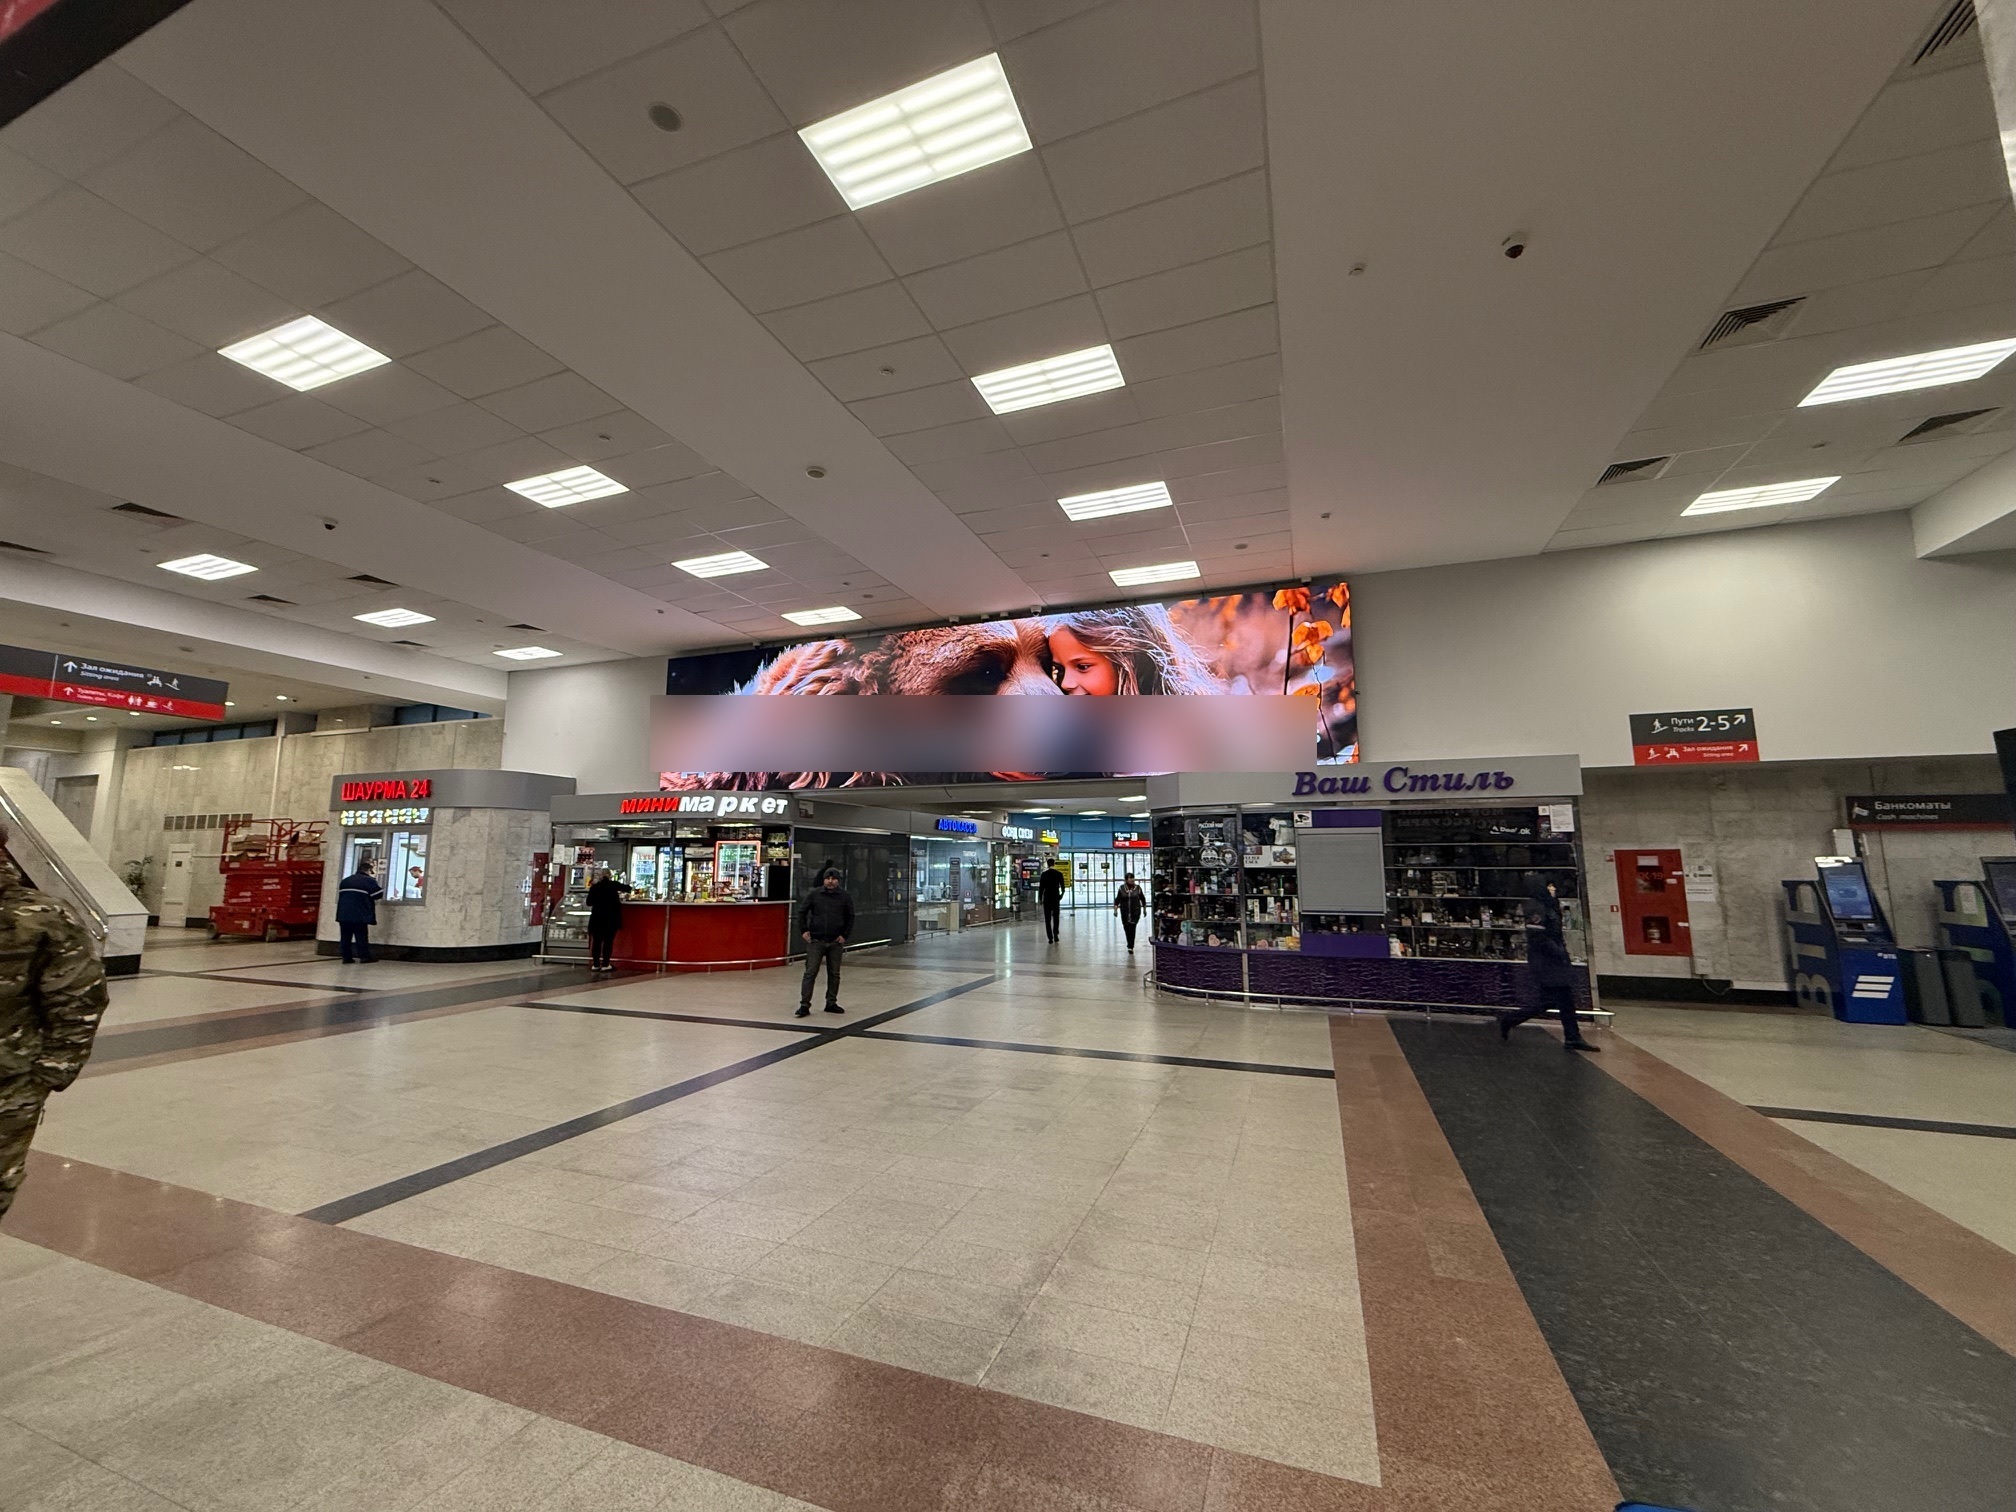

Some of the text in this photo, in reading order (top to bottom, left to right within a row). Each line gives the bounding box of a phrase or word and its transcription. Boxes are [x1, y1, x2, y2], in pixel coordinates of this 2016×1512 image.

[81, 662, 145, 679] Зал ожидания
[1670, 715, 1731, 732] Пути 2-5
[1696, 744, 1734, 752] ожидания
[341, 778, 430, 801] ШАУРМА 24
[1292, 766, 1514, 796] Ваш Стиль
[1874, 801, 1952, 810] Банкоматы
[1899, 812, 1940, 820] machines
